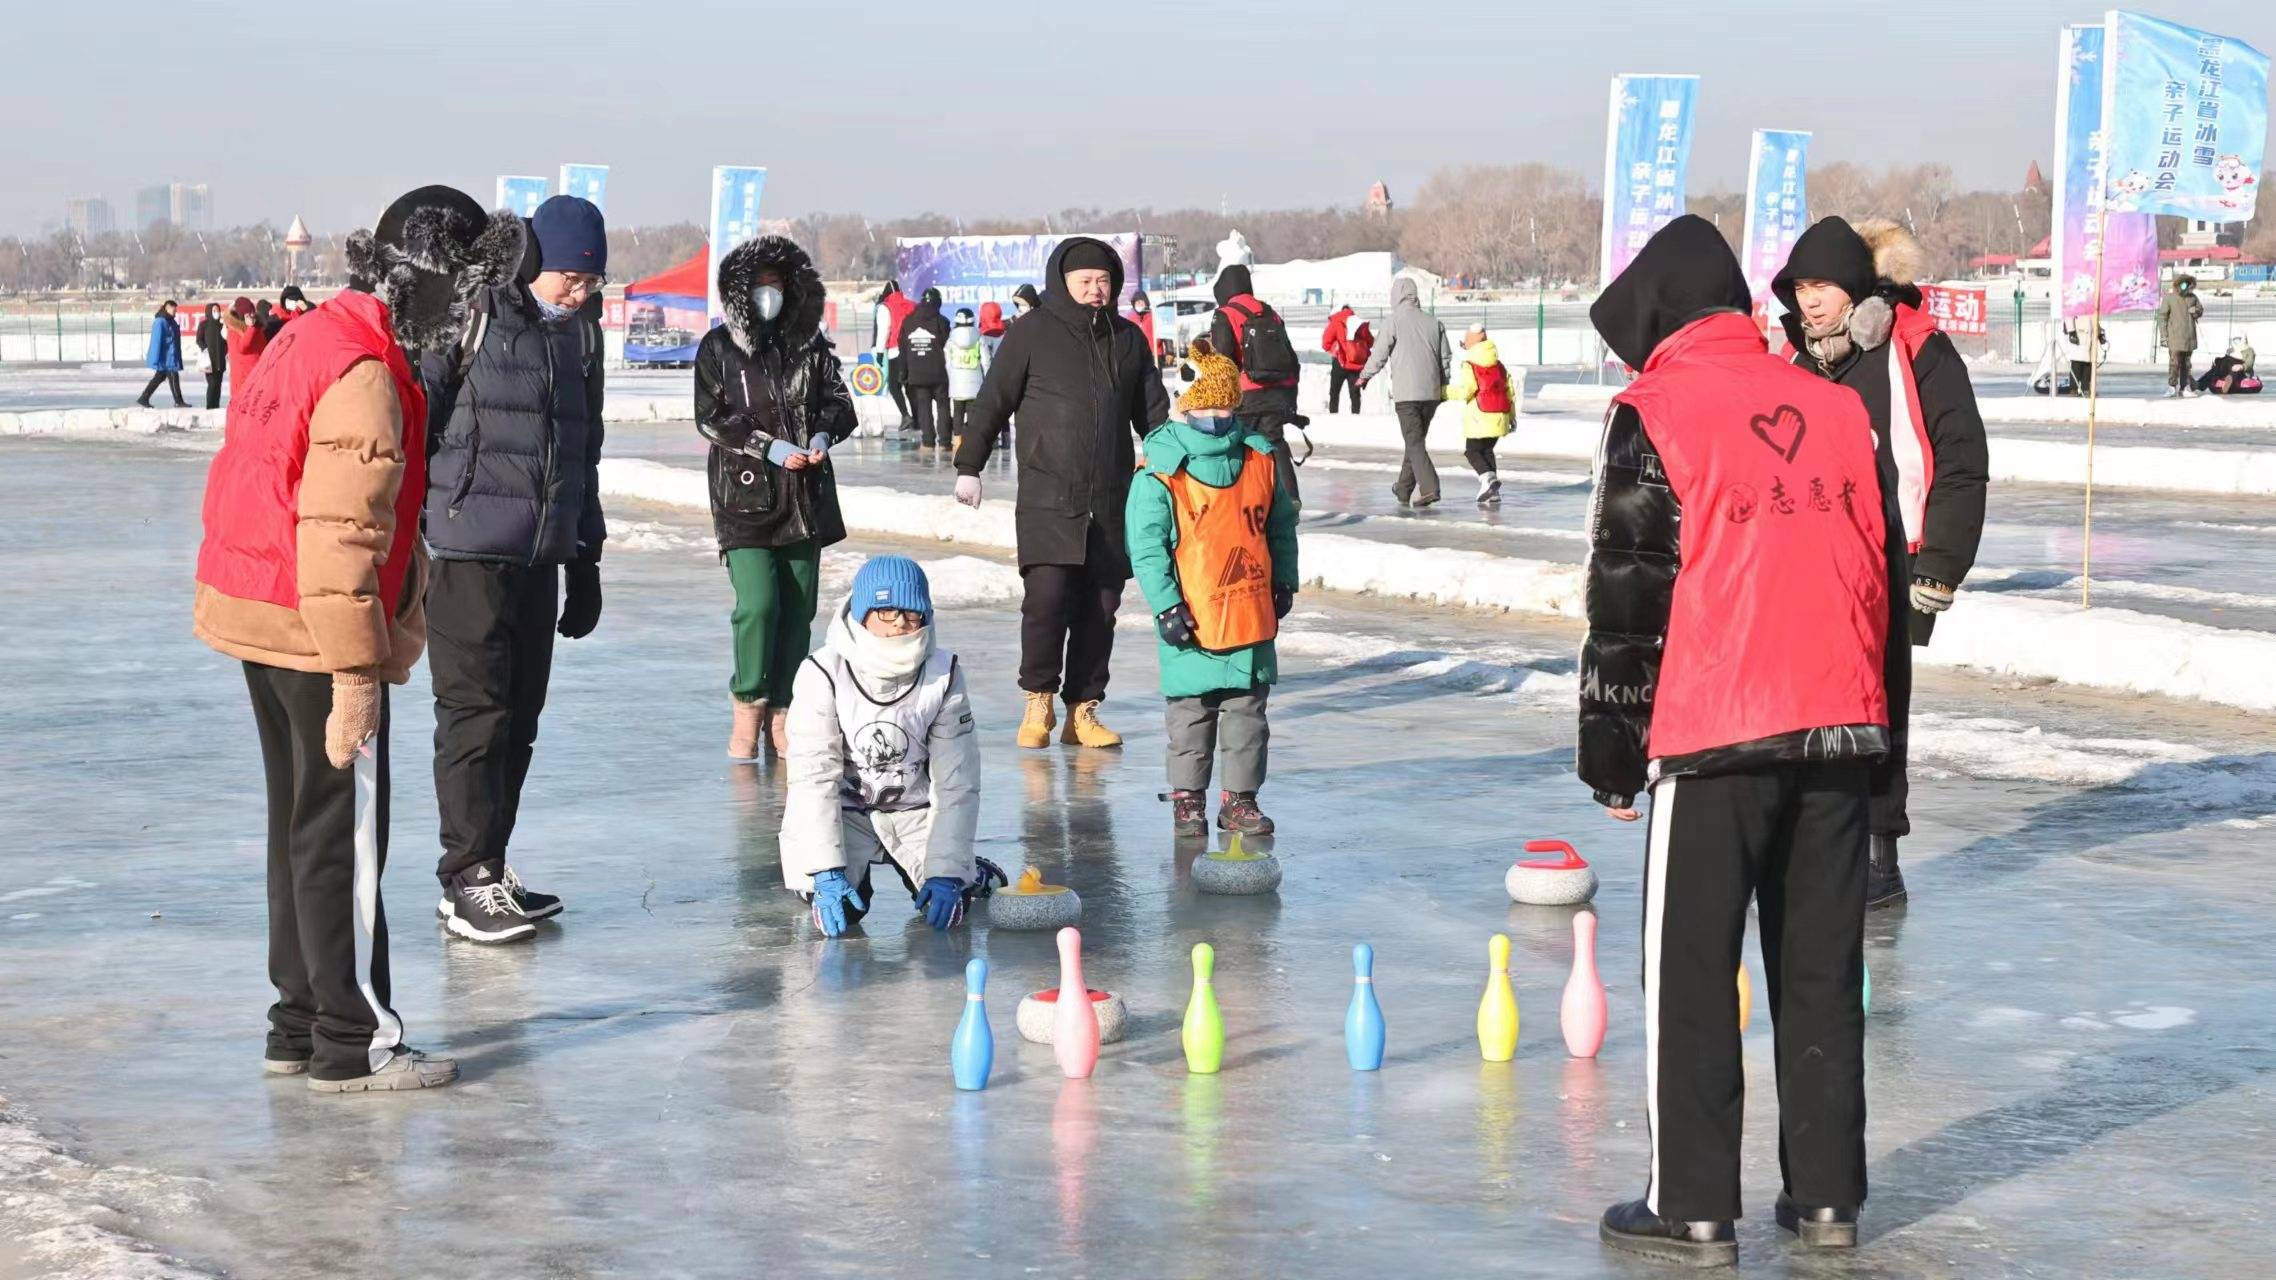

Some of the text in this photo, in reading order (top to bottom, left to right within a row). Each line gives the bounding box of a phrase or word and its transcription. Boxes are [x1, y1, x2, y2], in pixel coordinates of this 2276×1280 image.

[2154, 80, 2186, 191] 亲子运动会
[2193, 37, 2223, 167] 黑龙江省冰雪
[1629, 163, 1652, 252] 亲子运动
[1927, 289, 1979, 321] 运动
[1770, 475, 1856, 516] 志愿者
